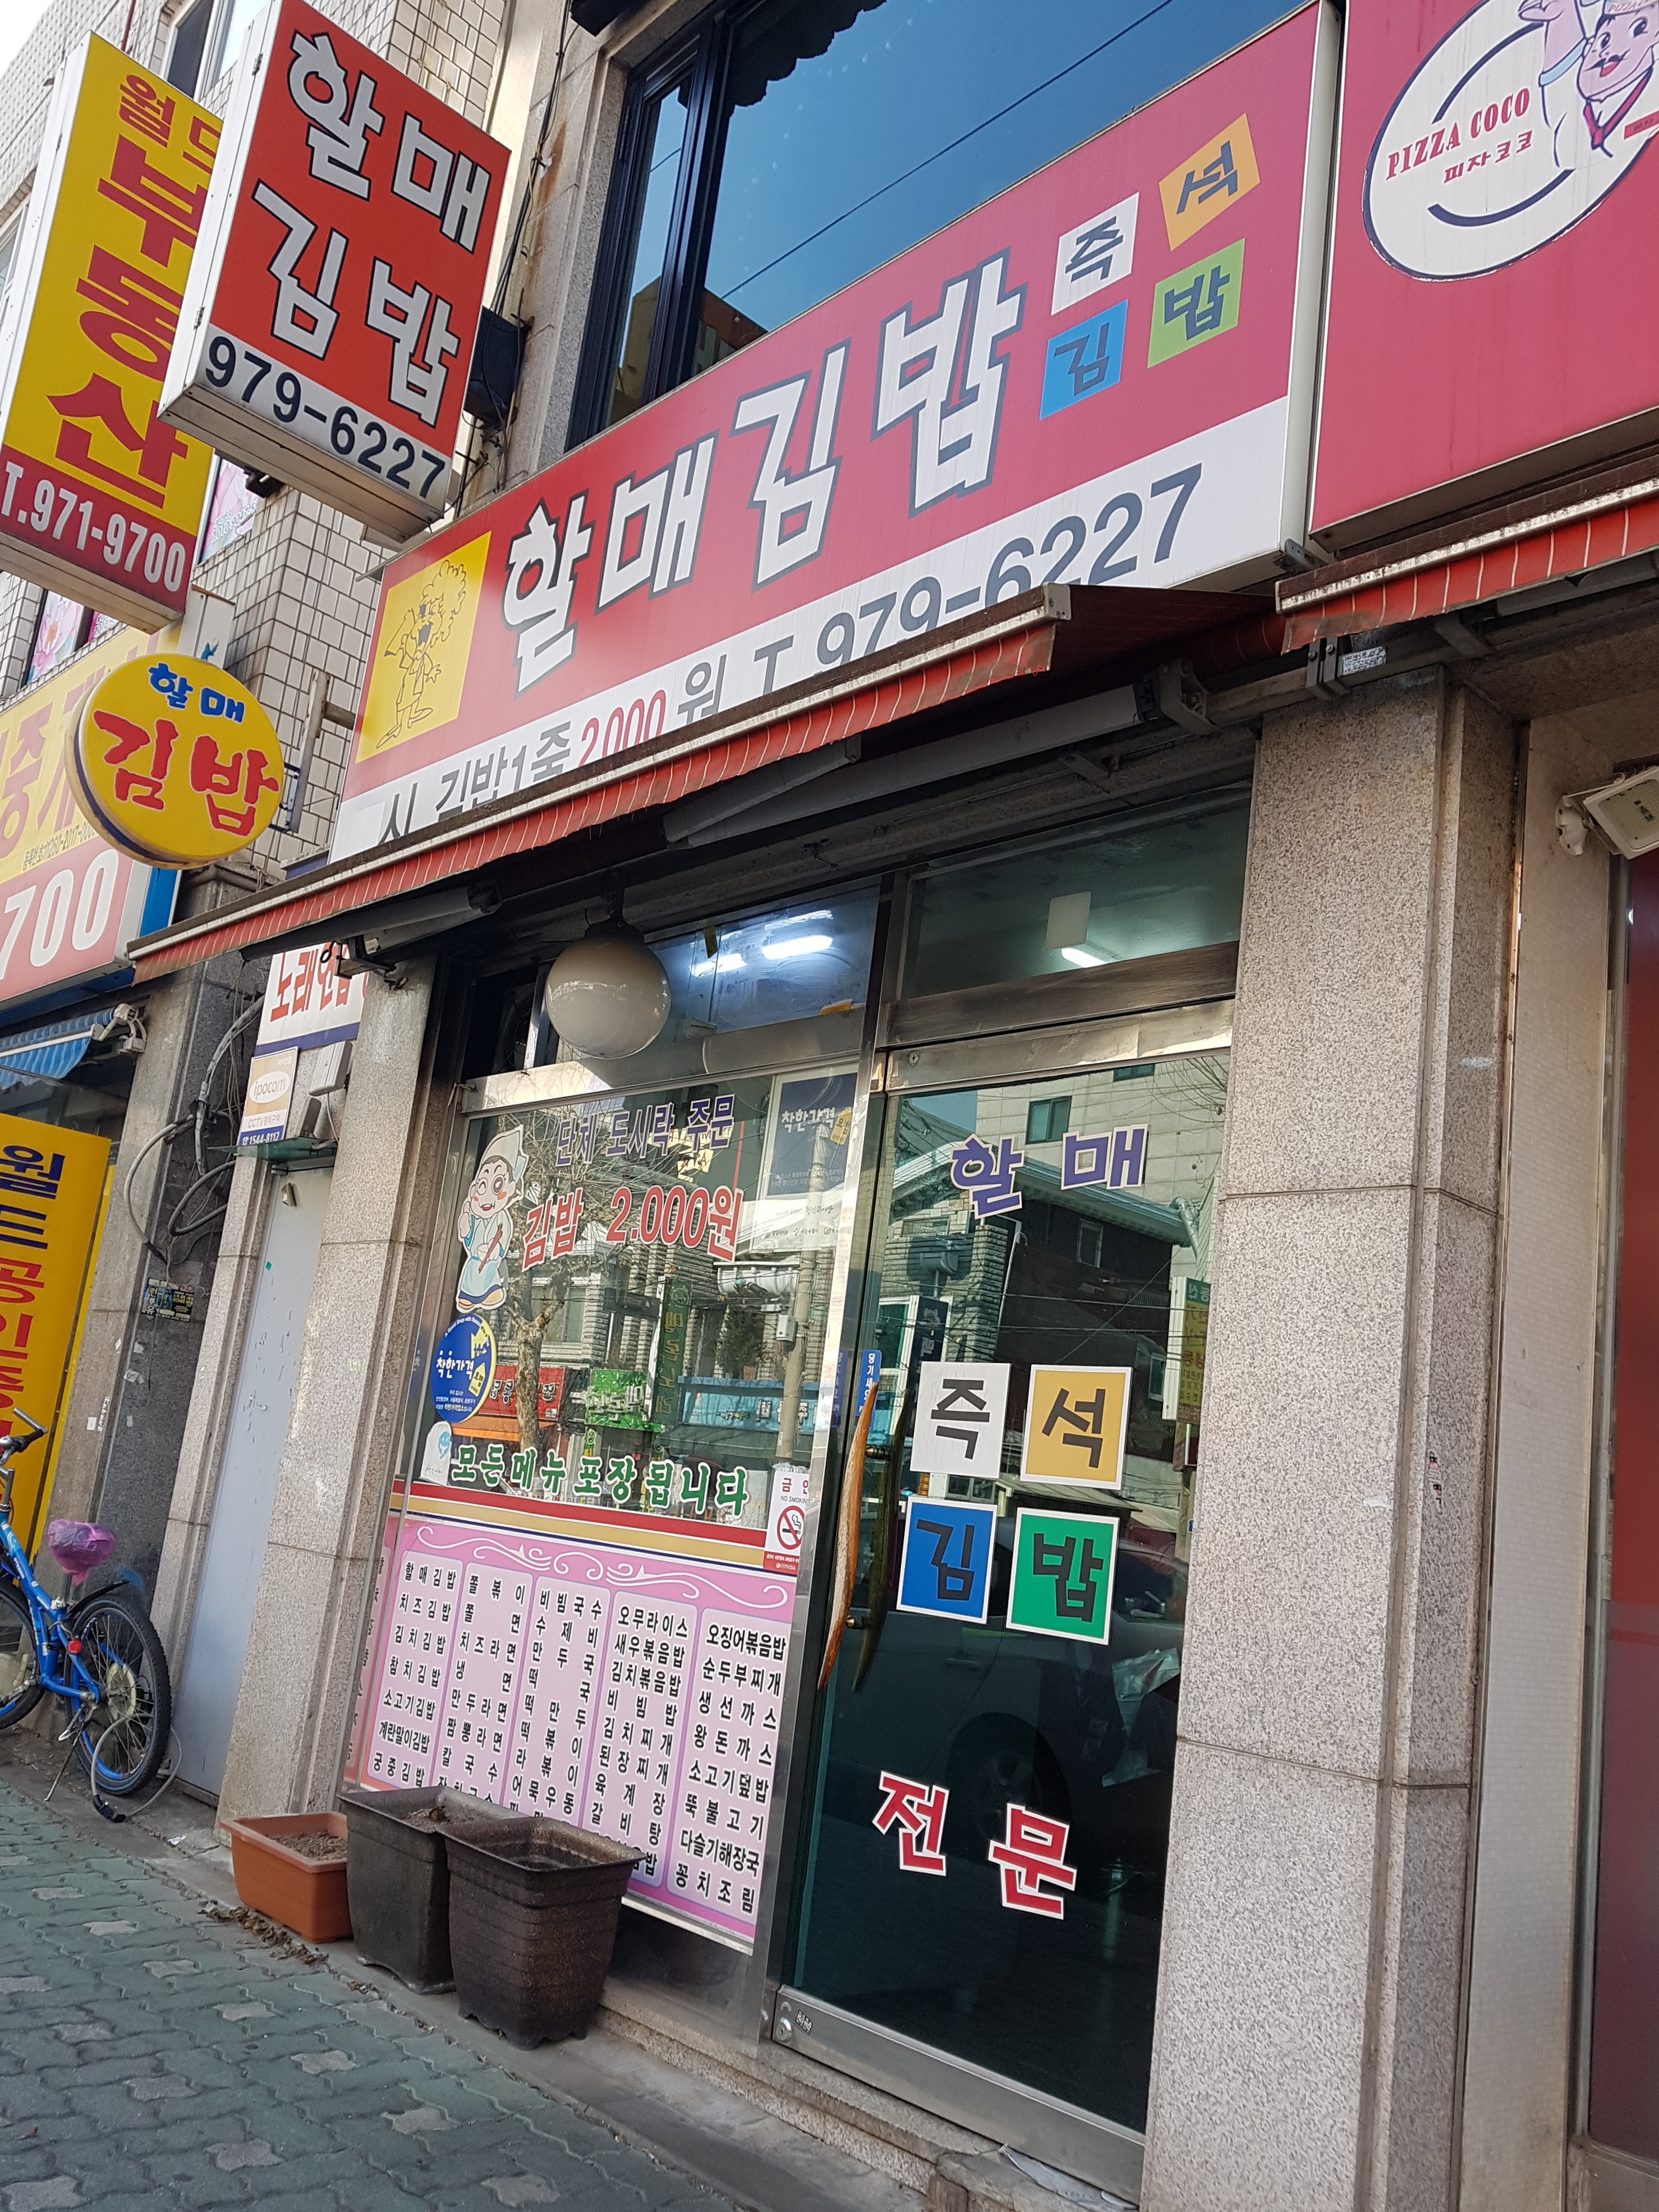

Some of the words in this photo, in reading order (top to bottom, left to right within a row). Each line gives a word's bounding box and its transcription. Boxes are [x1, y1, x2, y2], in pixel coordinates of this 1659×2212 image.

[287, 29, 492, 254] 할매
[1386, 122, 1461, 181] PIZZA
[1470, 88, 1530, 139] COCO
[46, 134, 207, 508] 부동산
[251, 178, 461, 430] 김밥
[205, 336, 447, 500] 979-6227
[1, 460, 186, 594] T.971-9700
[816, 462, 1202, 666] 979-6227
[147, 661, 246, 724] 할매
[91, 707, 280, 839] 김밥
[249, 1131, 280, 1145] 1544-8112
[254, 1079, 286, 1101] ipocom
[555, 1116, 598, 1167] 단체
[606, 1102, 674, 1158] 도시락
[687, 1093, 736, 1153] 주문
[950, 1124, 1148, 1220] 할매
[521, 1187, 584, 1272] 김밥
[606, 1184, 745, 1263] 2.000원
[436, 1350, 475, 1381] 착한가격
[789, 1496, 807, 1504] SMOKIN
[916, 1517, 1105, 1624] 김밥
[872, 1770, 1077, 1920] 전문
